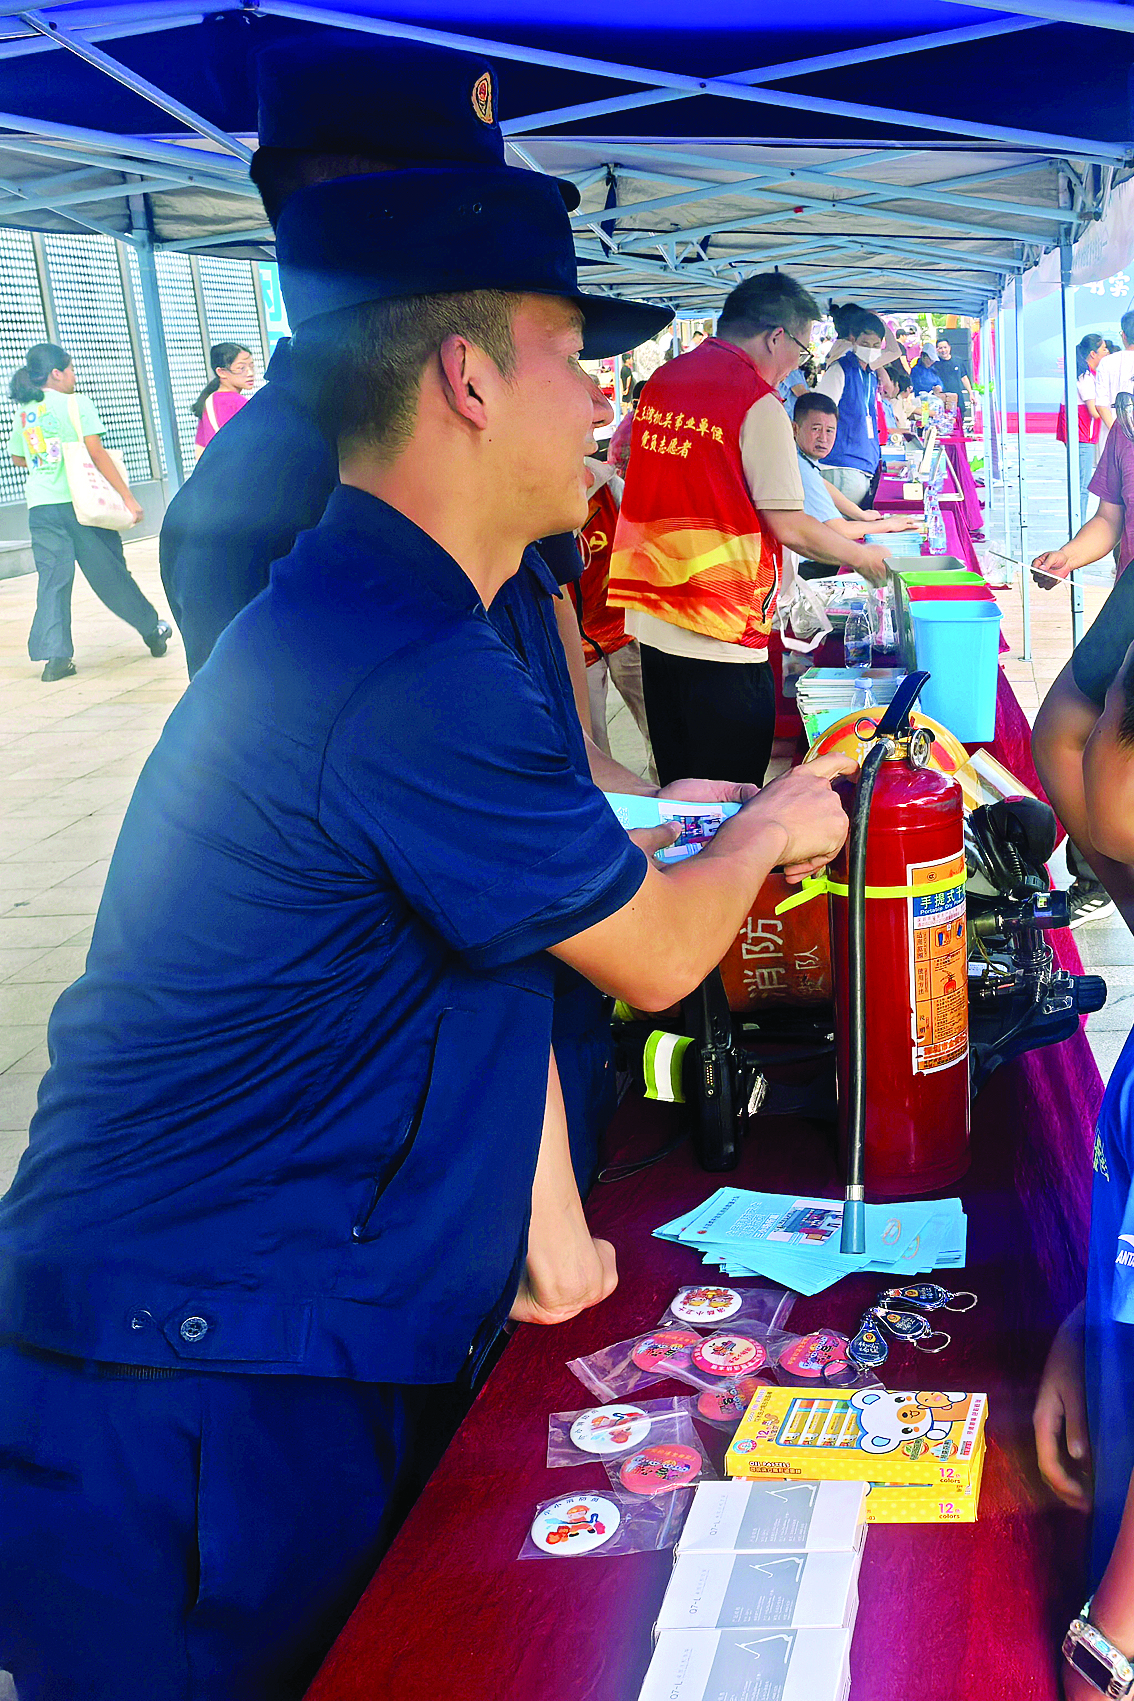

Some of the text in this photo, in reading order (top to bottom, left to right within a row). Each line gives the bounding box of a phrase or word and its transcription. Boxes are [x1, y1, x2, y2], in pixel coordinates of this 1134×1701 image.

[641, 430, 693, 459] 党员志愿者
[939, 1468, 954, 1478] 12
[939, 1503, 954, 1513] 12
[689, 1597, 701, 1614] Q7-L
[669, 1681, 683, 1700] Q7-L
